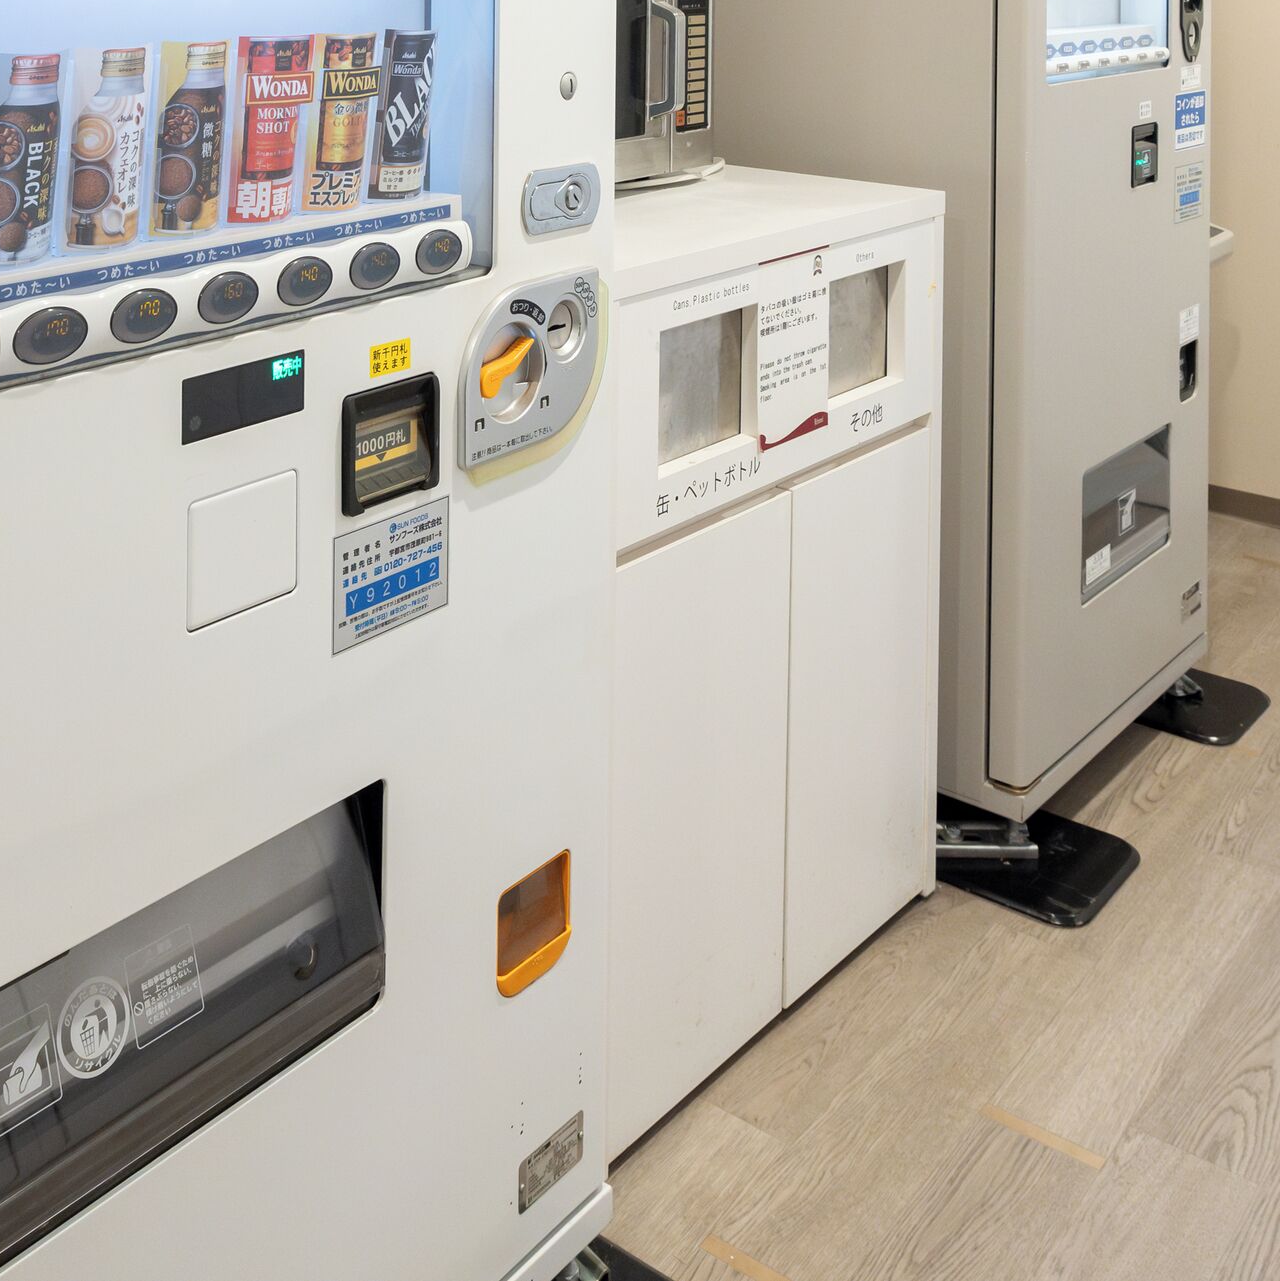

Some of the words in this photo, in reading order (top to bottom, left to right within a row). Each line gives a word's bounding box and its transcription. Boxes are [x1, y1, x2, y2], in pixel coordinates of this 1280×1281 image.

[251, 74, 309, 100] WONDA
[328, 70, 378, 97] WONDA
[256, 121, 291, 135] SHOT
[1180, 111, 1201, 128] されたら
[23, 142, 45, 210] BLACK
[116, 131, 131, 195] カフェオレ
[855, 250, 875, 264] Others
[299, 265, 319, 283] 140
[372, 339, 409, 362] 新千円札
[272, 355, 304, 382] 販売中
[372, 355, 409, 374] 使えます
[760, 360, 775, 371] Please
[850, 403, 884, 433] その他
[355, 427, 408, 458] 1000円札
[655, 455, 762, 518] 缶・ペットボトル
[383, 542, 443, 572] 0120-727-456
[74, 1034, 121, 1072] リサイクル
